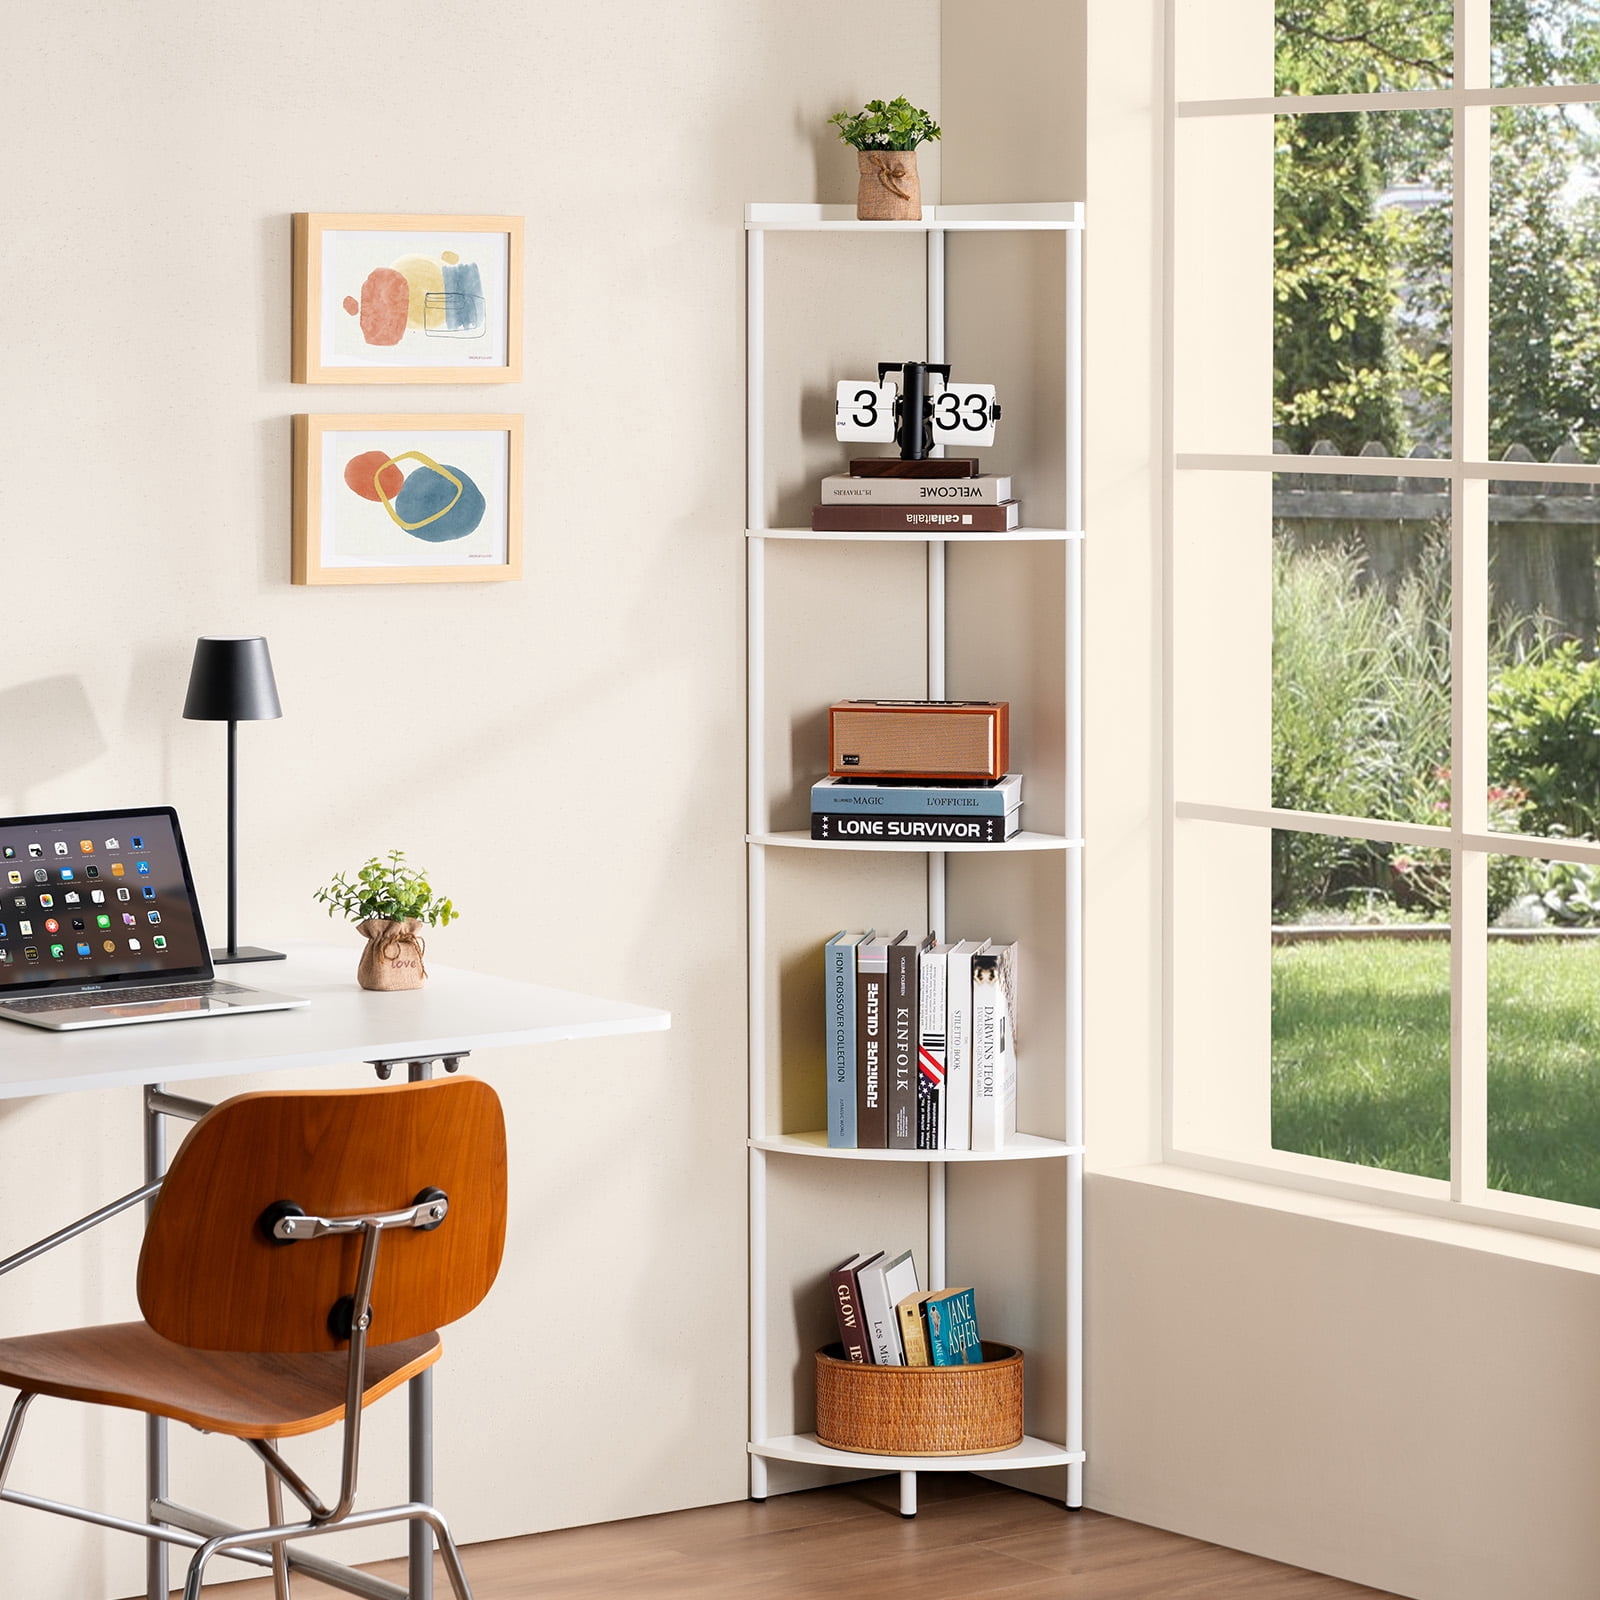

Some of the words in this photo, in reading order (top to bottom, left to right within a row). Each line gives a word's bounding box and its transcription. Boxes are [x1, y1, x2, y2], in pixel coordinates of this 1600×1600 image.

[852, 389, 878, 428] 3
[935, 392, 988, 432] 33
[919, 486, 983, 498] WELCOME
[853, 796, 885, 805] MAGIC
[927, 797, 979, 807] L'OFFICIEL
[837, 820, 883, 835] LONE
[887, 821, 981, 838] SURVIVOR
[835, 952, 844, 974] FION
[836, 976, 844, 1027] CROSSOVER
[867, 983, 879, 1036] CULTURE
[896, 1007, 909, 1091] KINFOLK
[984, 1006, 994, 1060] DARWINS
[836, 1030, 845, 1083] COLLECTION
[953, 1049, 961, 1071] BOOK
[984, 1063, 994, 1097] TEORI
[837, 1284, 857, 1329] GLOW
[947, 1294, 972, 1327] JANE
[874, 1320, 883, 1339] Les
[879, 1345, 890, 1365] Mis
[949, 1319, 981, 1356] ASHER
